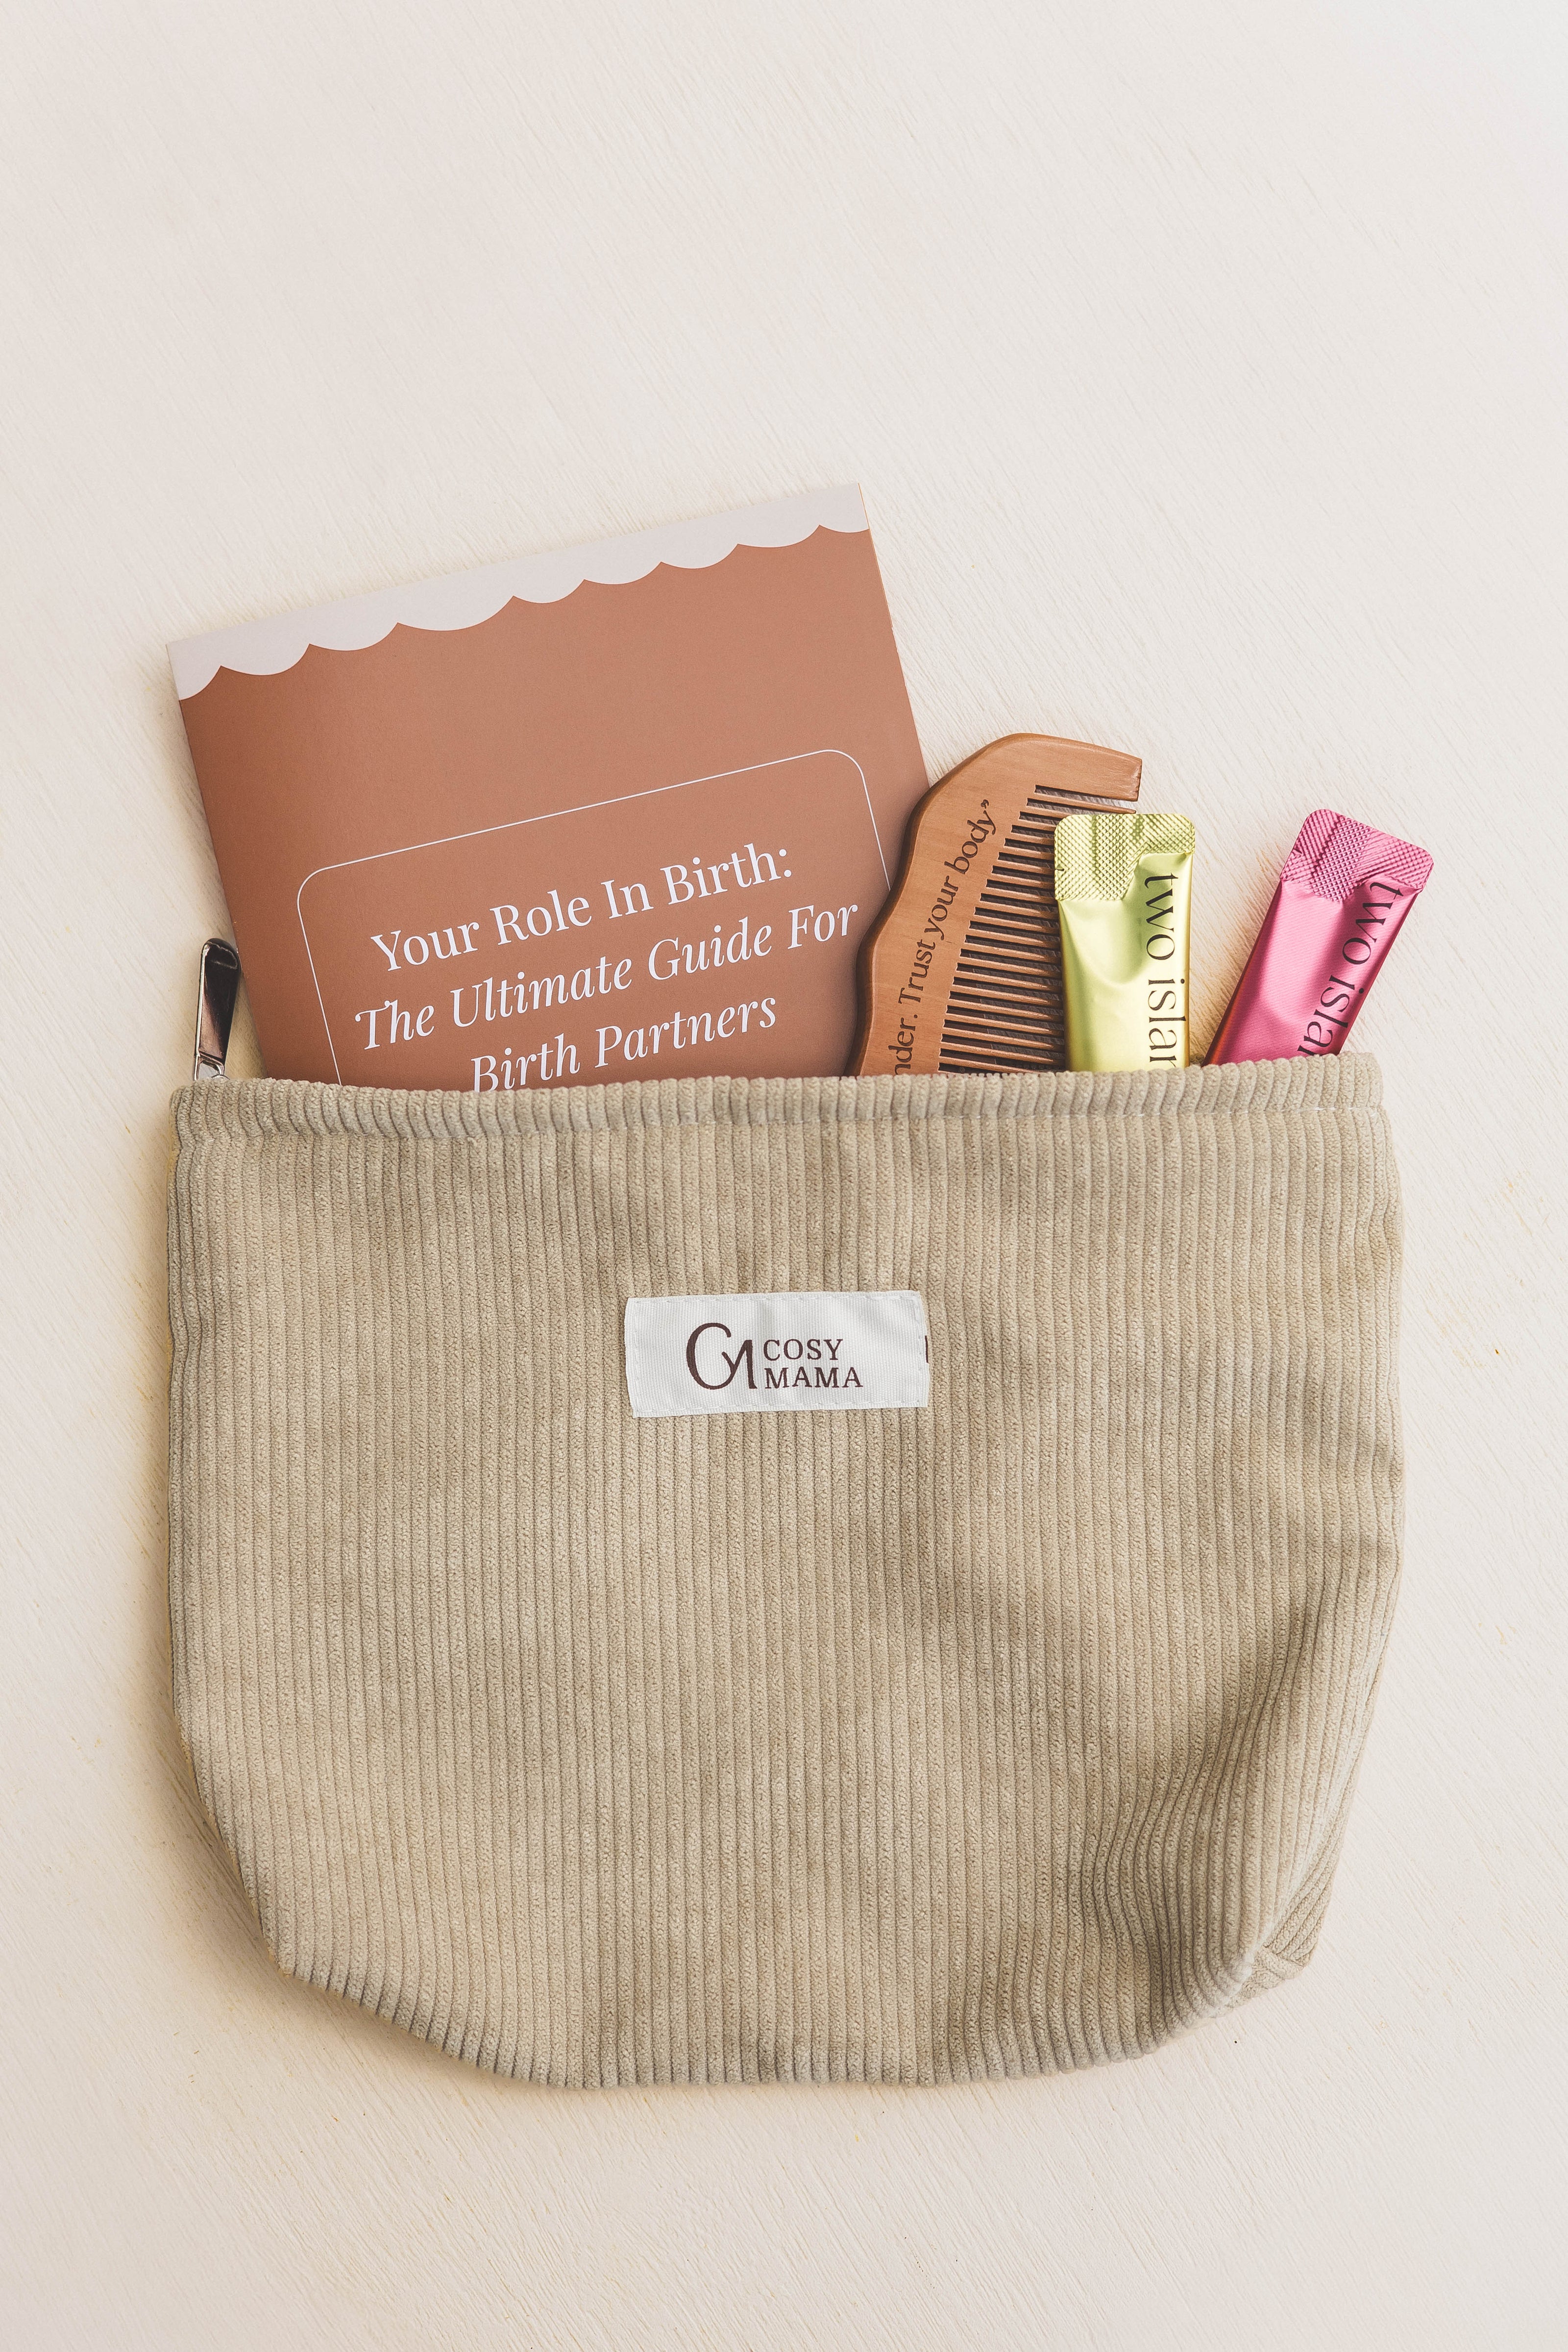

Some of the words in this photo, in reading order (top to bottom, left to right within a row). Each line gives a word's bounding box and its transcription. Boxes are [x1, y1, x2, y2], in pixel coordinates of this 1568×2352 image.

[371, 922, 480, 971] Your
[490, 889, 592, 945] Role
[601, 880, 654, 919] In
[660, 843, 792, 905] Birth:
[898, 939, 936, 1004] Trust
[924, 875, 959, 941] your
[1145, 873, 1178, 960] two
[1342, 881, 1403, 965] two
[355, 999, 435, 1050] The
[450, 956, 632, 1027] Ultimate
[648, 916, 772, 980] Guide
[787, 905, 858, 949] For
[471, 1033, 580, 1092] Birth
[594, 998, 776, 1068] Partners
[763, 1339, 843, 1361] COSY
[764, 1366, 863, 1389] MAMA
